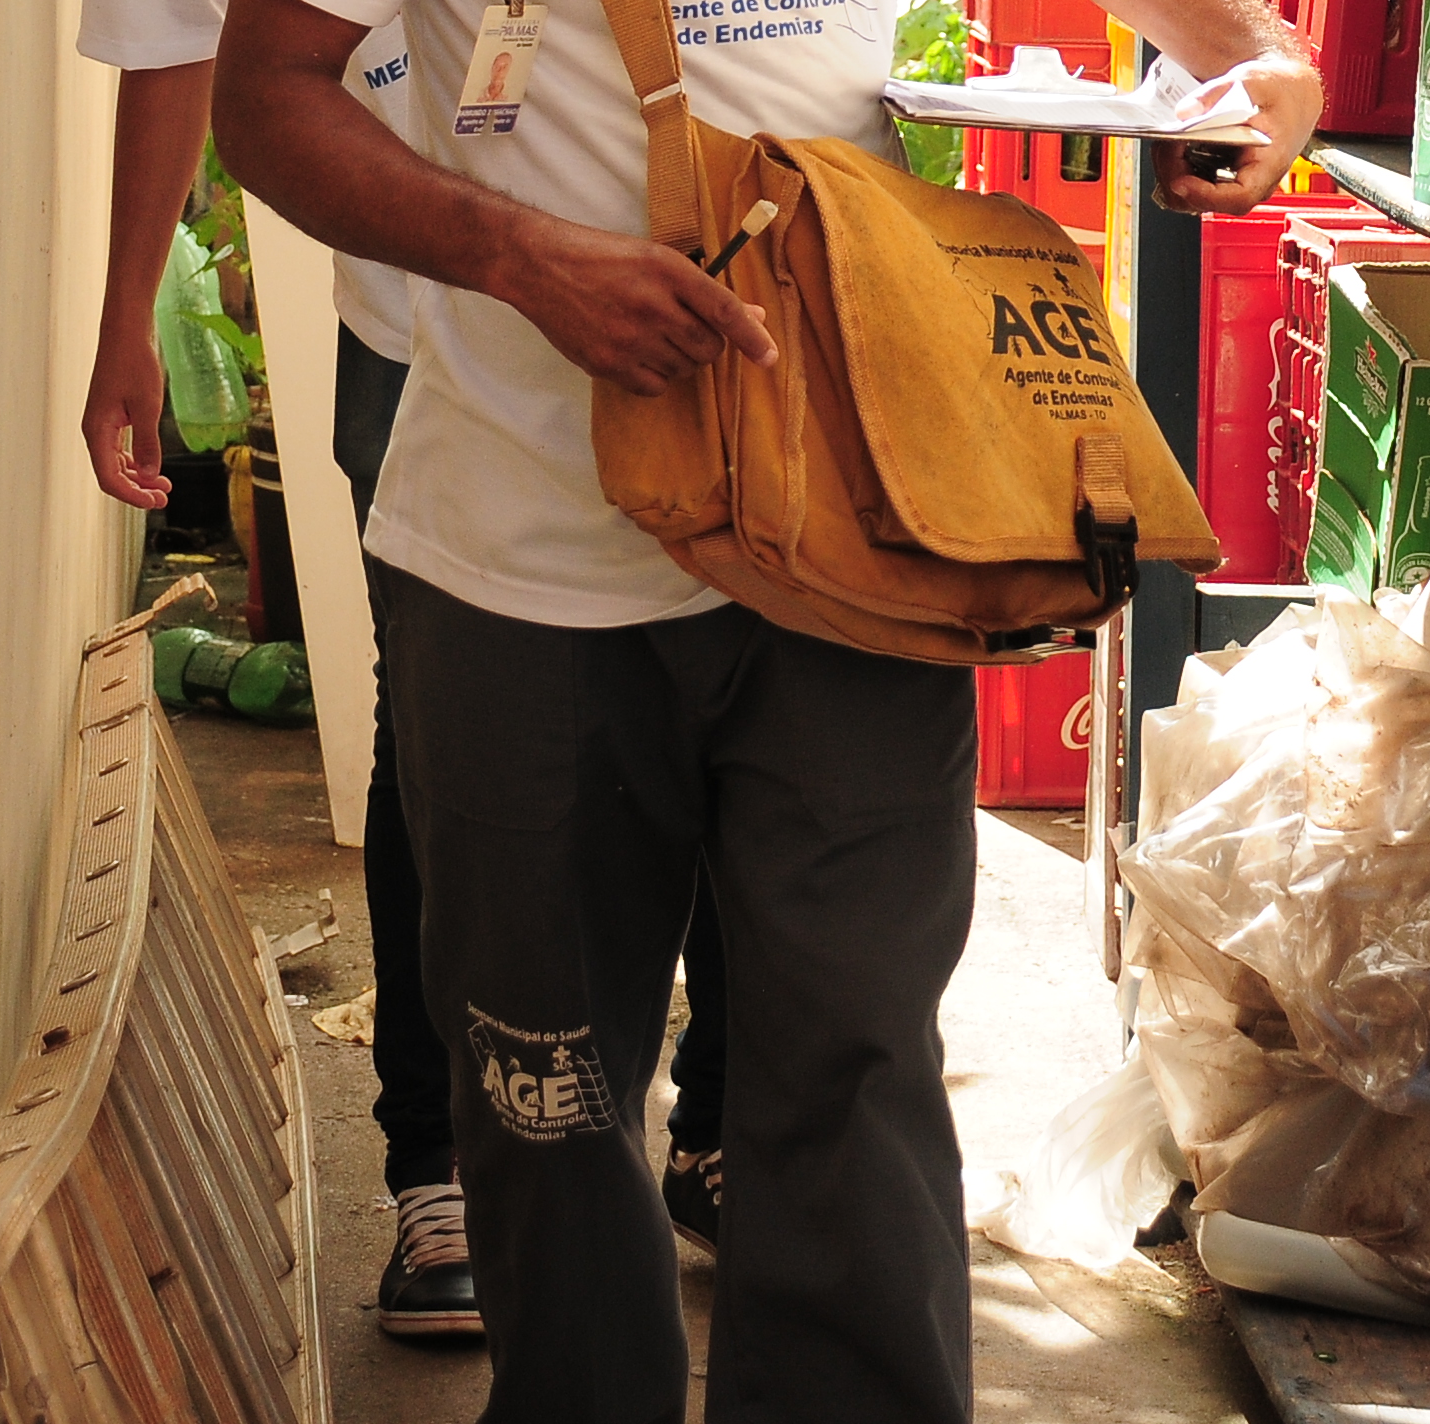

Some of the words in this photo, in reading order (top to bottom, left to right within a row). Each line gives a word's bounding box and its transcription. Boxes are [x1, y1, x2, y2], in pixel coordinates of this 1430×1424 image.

[676, 25, 708, 46] de
[715, 18, 825, 44] Endemias
[979, 244, 1035, 263] Municipal
[1036, 247, 1051, 261] de
[991, 292, 1112, 367] ACE
[1003, 366, 1055, 388] Agente
[1057, 369, 1073, 385] de
[1032, 389, 1049, 405] de
[1050, 389, 1114, 408] Endemias
[1415, 397, 1425, 406] 12
[1048, 409, 1087, 420] PALMAS
[1094, 409, 1107, 421] TO
[498, 1020, 541, 1043] Municipal
[543, 1031, 557, 1042] de
[483, 1055, 580, 1119] ACE
[516, 1114, 529, 1126] de
[531, 1112, 587, 1129] Controle
[511, 1122, 567, 1141] Endemias
